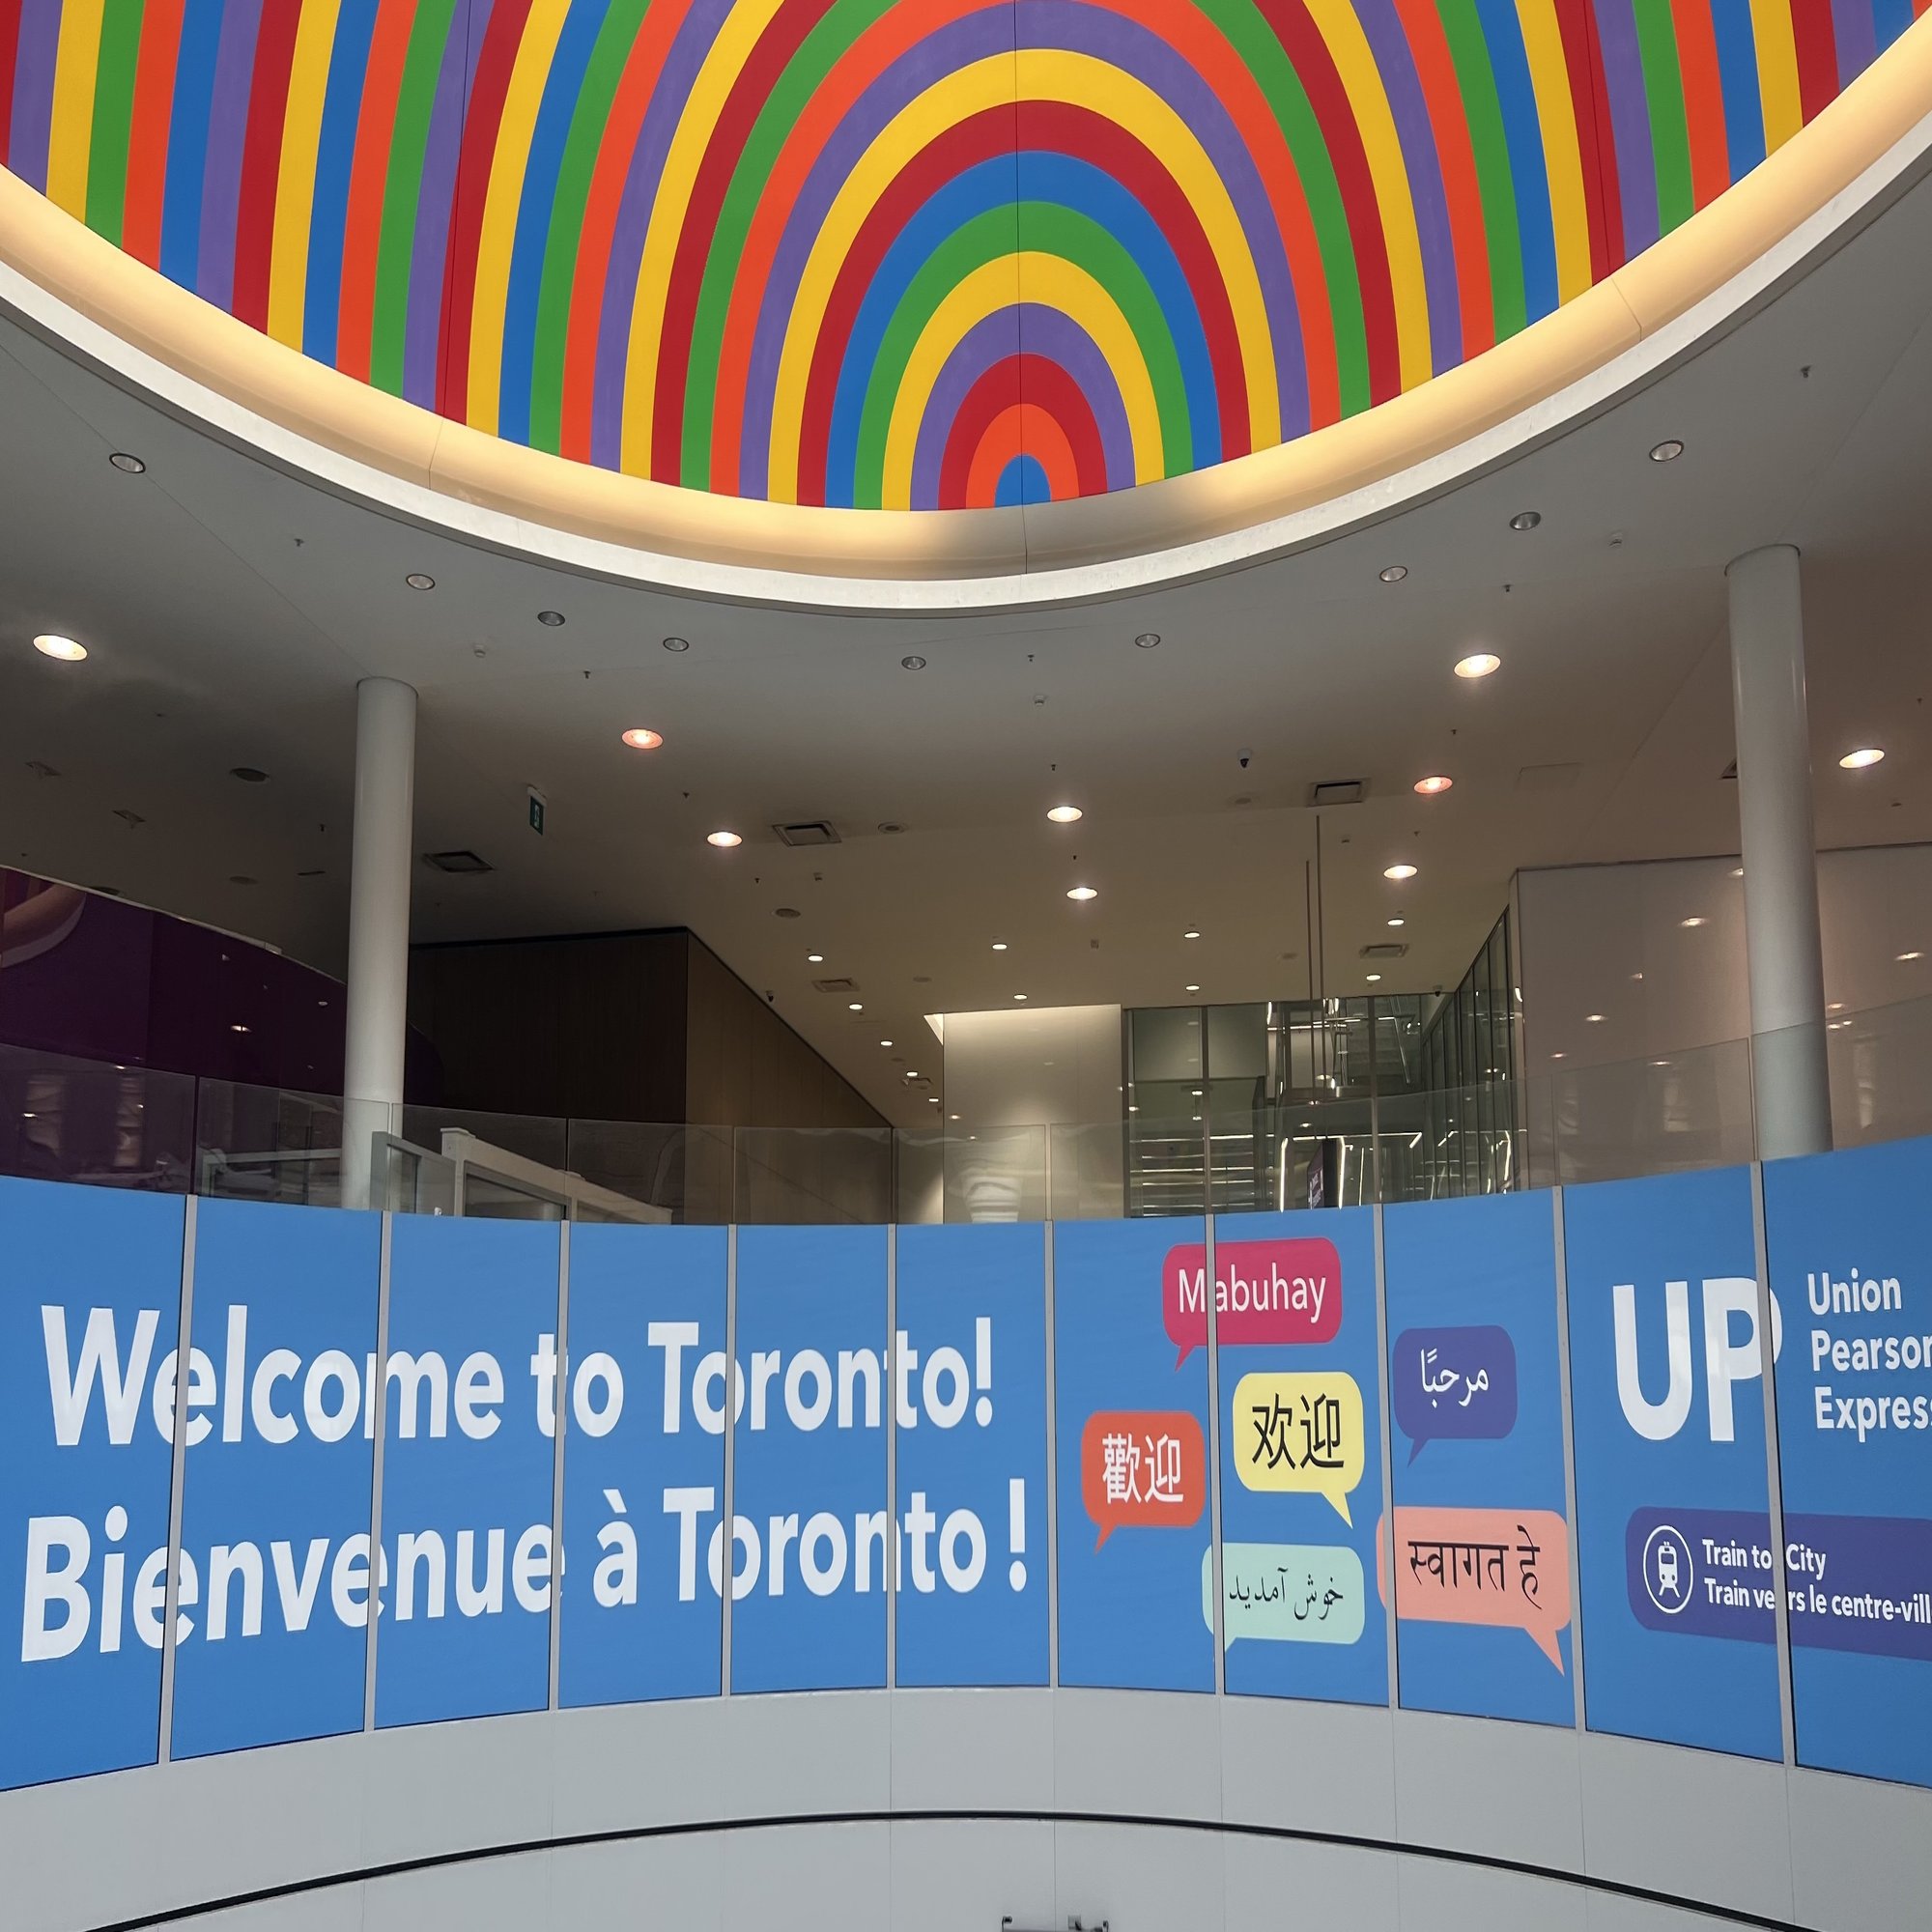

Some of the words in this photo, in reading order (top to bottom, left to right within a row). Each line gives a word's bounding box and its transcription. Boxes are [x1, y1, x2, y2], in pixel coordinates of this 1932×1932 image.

[1178, 1262, 1326, 1323] Mabuhay
[1807, 1267, 1902, 1316] Union
[41, 1304, 504, 1447] Welcome
[530, 1333, 624, 1438] to
[648, 1317, 993, 1435] Toronto!
[1612, 1276, 1783, 1443] UP
[1251, 1393, 1345, 1470] 欢迎
[1814, 1385, 1932, 1443] Expres
[1101, 1433, 1184, 1504] 歡迎
[21, 1504, 566, 1662] Bienvenue
[592, 1489, 638, 1608] à
[664, 1487, 987, 1603] Toronto
[1407, 1541, 1510, 1592] स्वागत
[1702, 1539, 1747, 1568] Train
[1751, 1545, 1773, 1570] to
[1786, 1543, 1827, 1580] City
[1293, 1573, 1344, 1621] خوش
[1704, 1577, 1750, 1607] Train
[1752, 1589, 1805, 1612] vers
[1809, 1584, 1828, 1614] le
[1832, 1593, 1932, 1625] centre-vill
